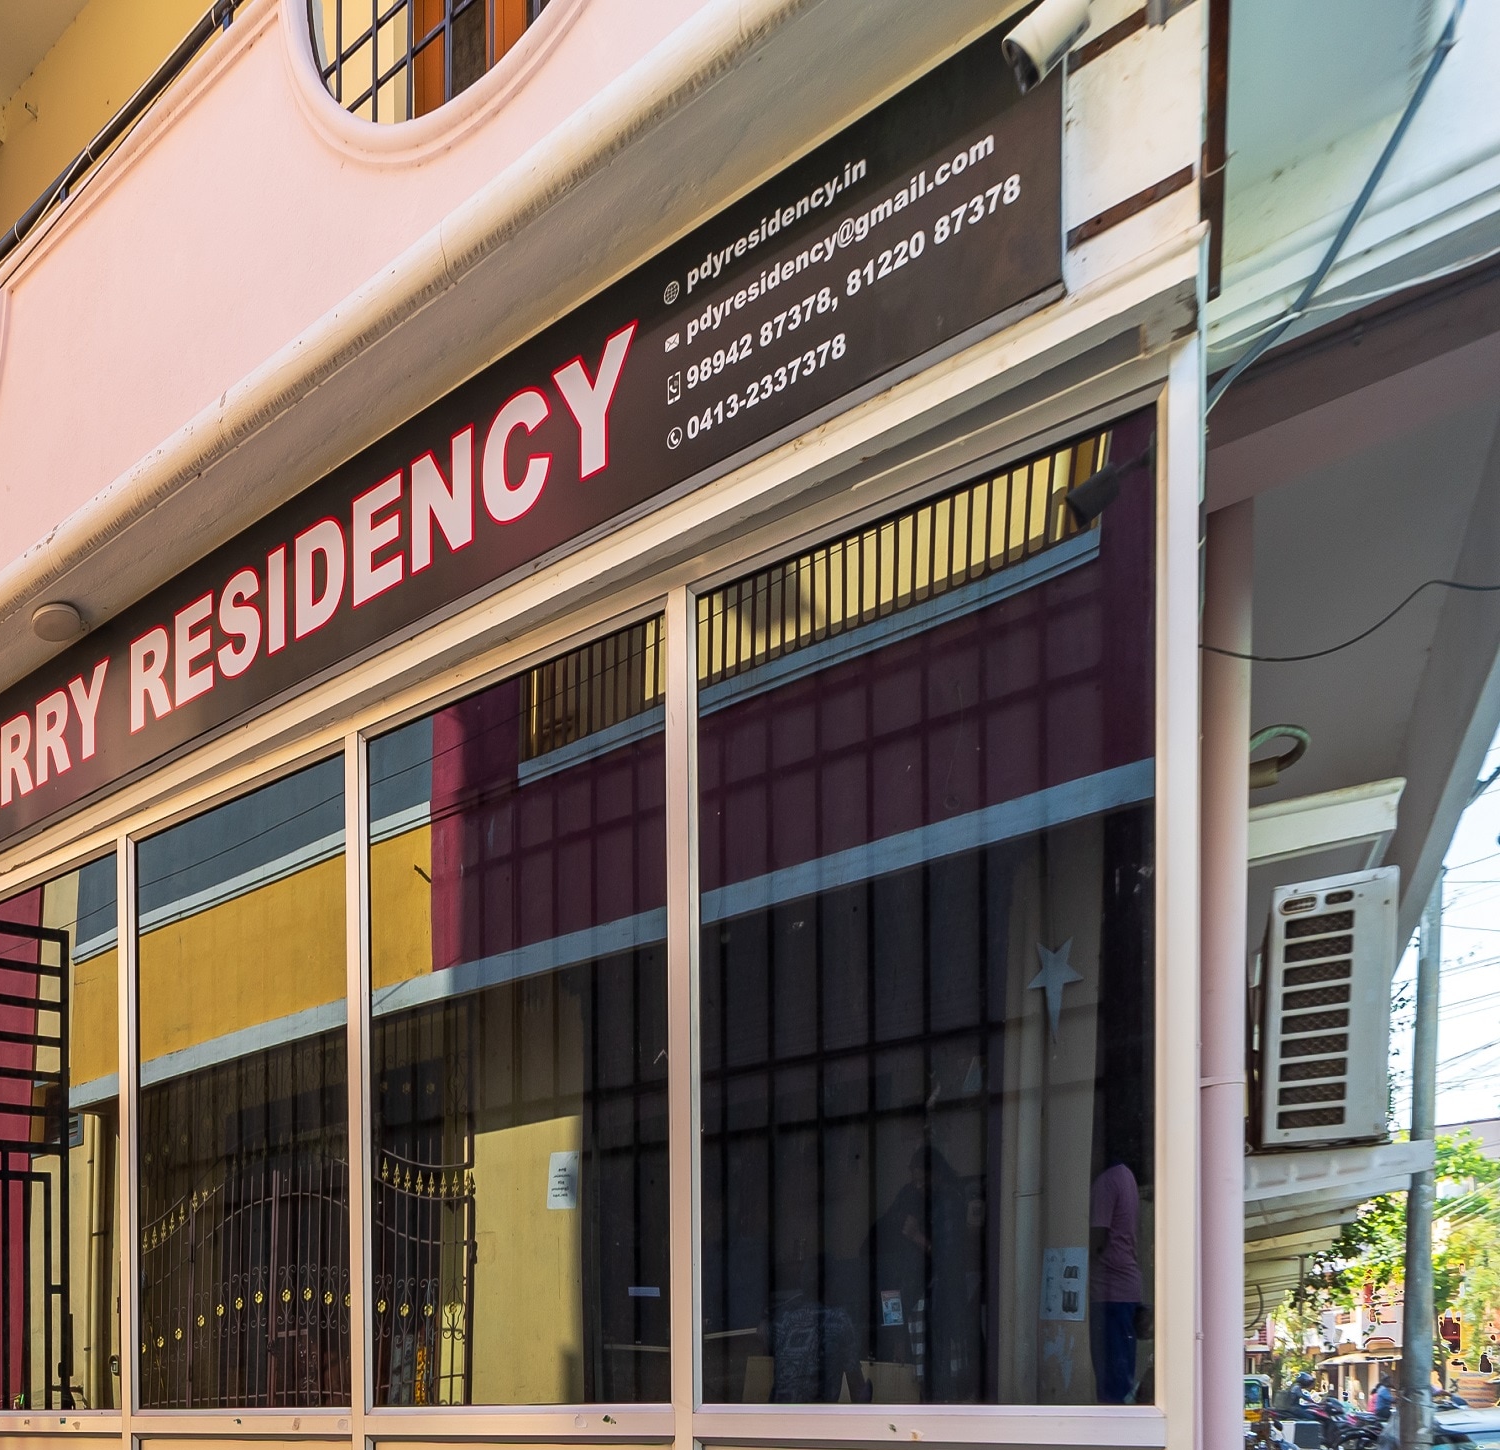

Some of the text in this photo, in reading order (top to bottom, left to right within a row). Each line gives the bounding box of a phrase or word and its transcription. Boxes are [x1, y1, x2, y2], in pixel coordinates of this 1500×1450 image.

[686, 155, 868, 295] pdyresidency.in
[686, 133, 995, 345] pdyresidency@gmail.com
[686, 174, 1022, 391] 98942 87378, 81220 87378
[686, 332, 847, 441] 0413-2337378
[128, 319, 640, 735] RESIDENCY
